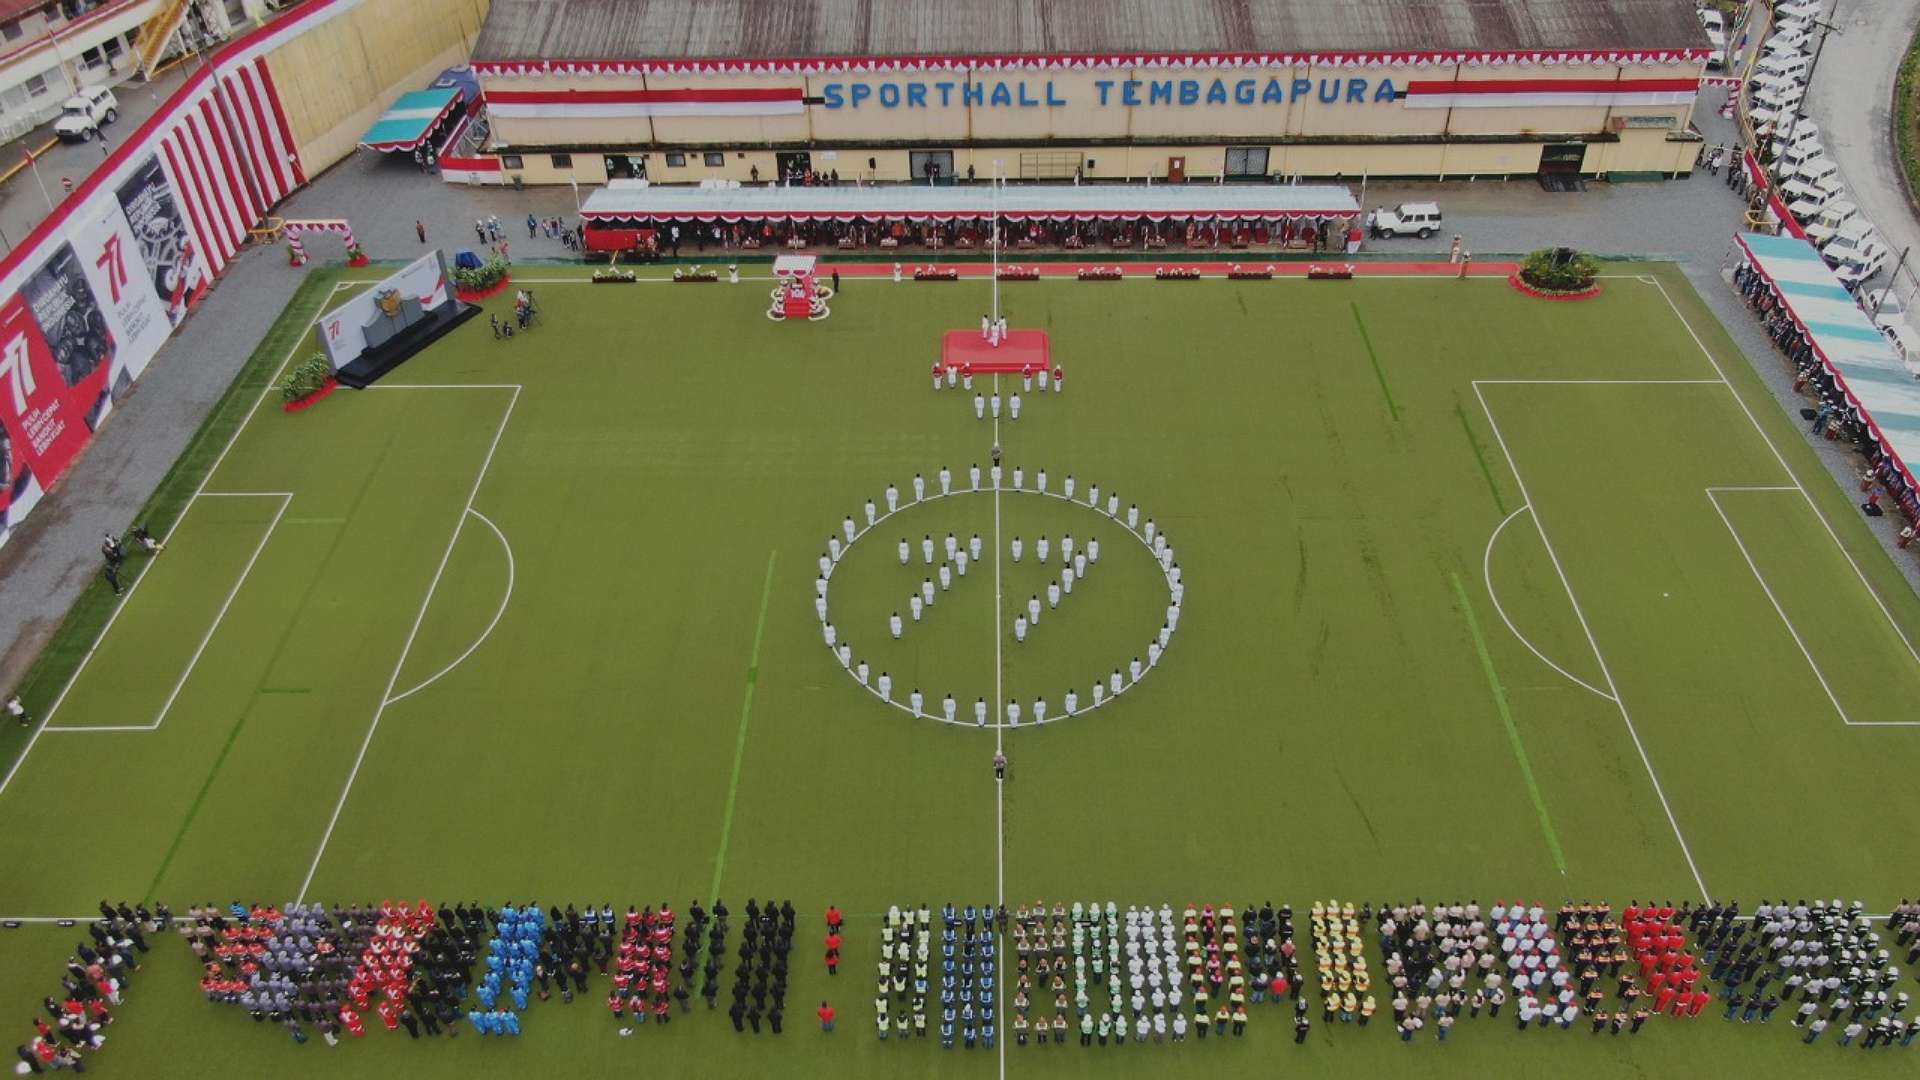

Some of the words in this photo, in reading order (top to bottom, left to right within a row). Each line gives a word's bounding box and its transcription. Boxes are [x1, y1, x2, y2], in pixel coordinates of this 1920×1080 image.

[824, 82, 1065, 109] SPORTHALL
[1098, 79, 1398, 105] TEMBAGAPURA
[96, 233, 129, 304] 77
[0, 330, 36, 416] 77
